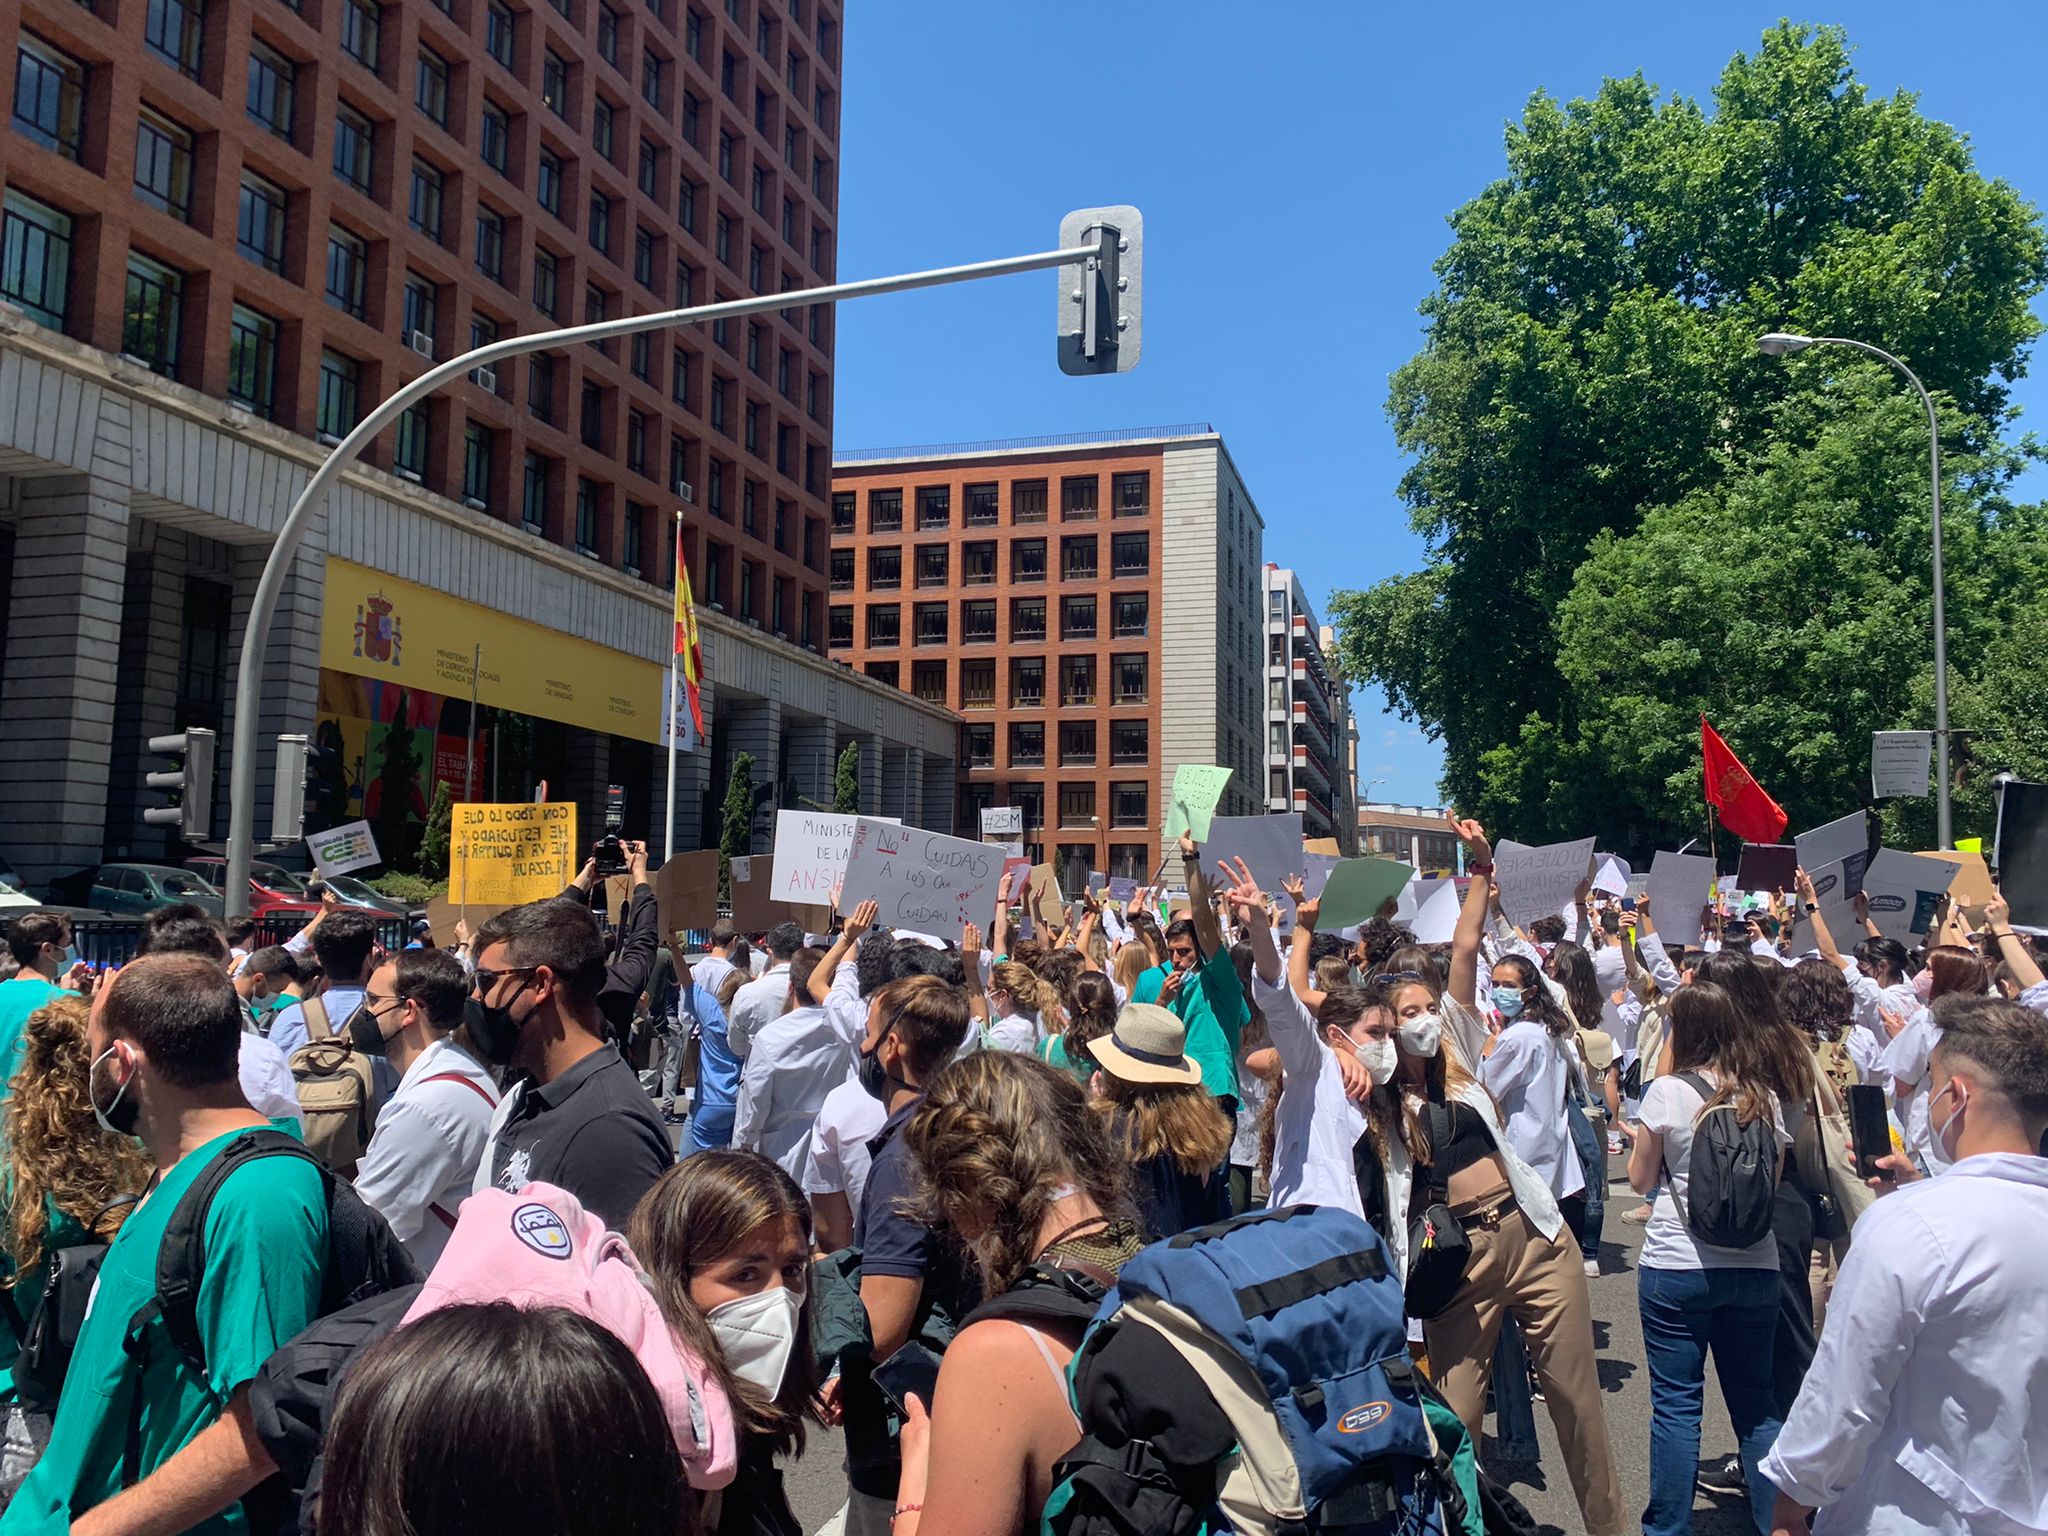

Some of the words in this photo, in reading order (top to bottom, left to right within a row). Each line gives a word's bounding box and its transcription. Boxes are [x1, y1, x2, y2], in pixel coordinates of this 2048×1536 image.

[436, 648, 469, 664] MINISTERIO
[436, 659, 445, 668] DE
[445, 661, 475, 675] DERECHO
[478, 669, 502, 683] OCIALES
[441, 671, 467, 683] AGENDA
[665, 723, 686, 738] 230
[983, 813, 1020, 830] #25M
[312, 836, 344, 849] Sindicato
[816, 846, 832, 860] DE
[879, 860, 893, 878] A
